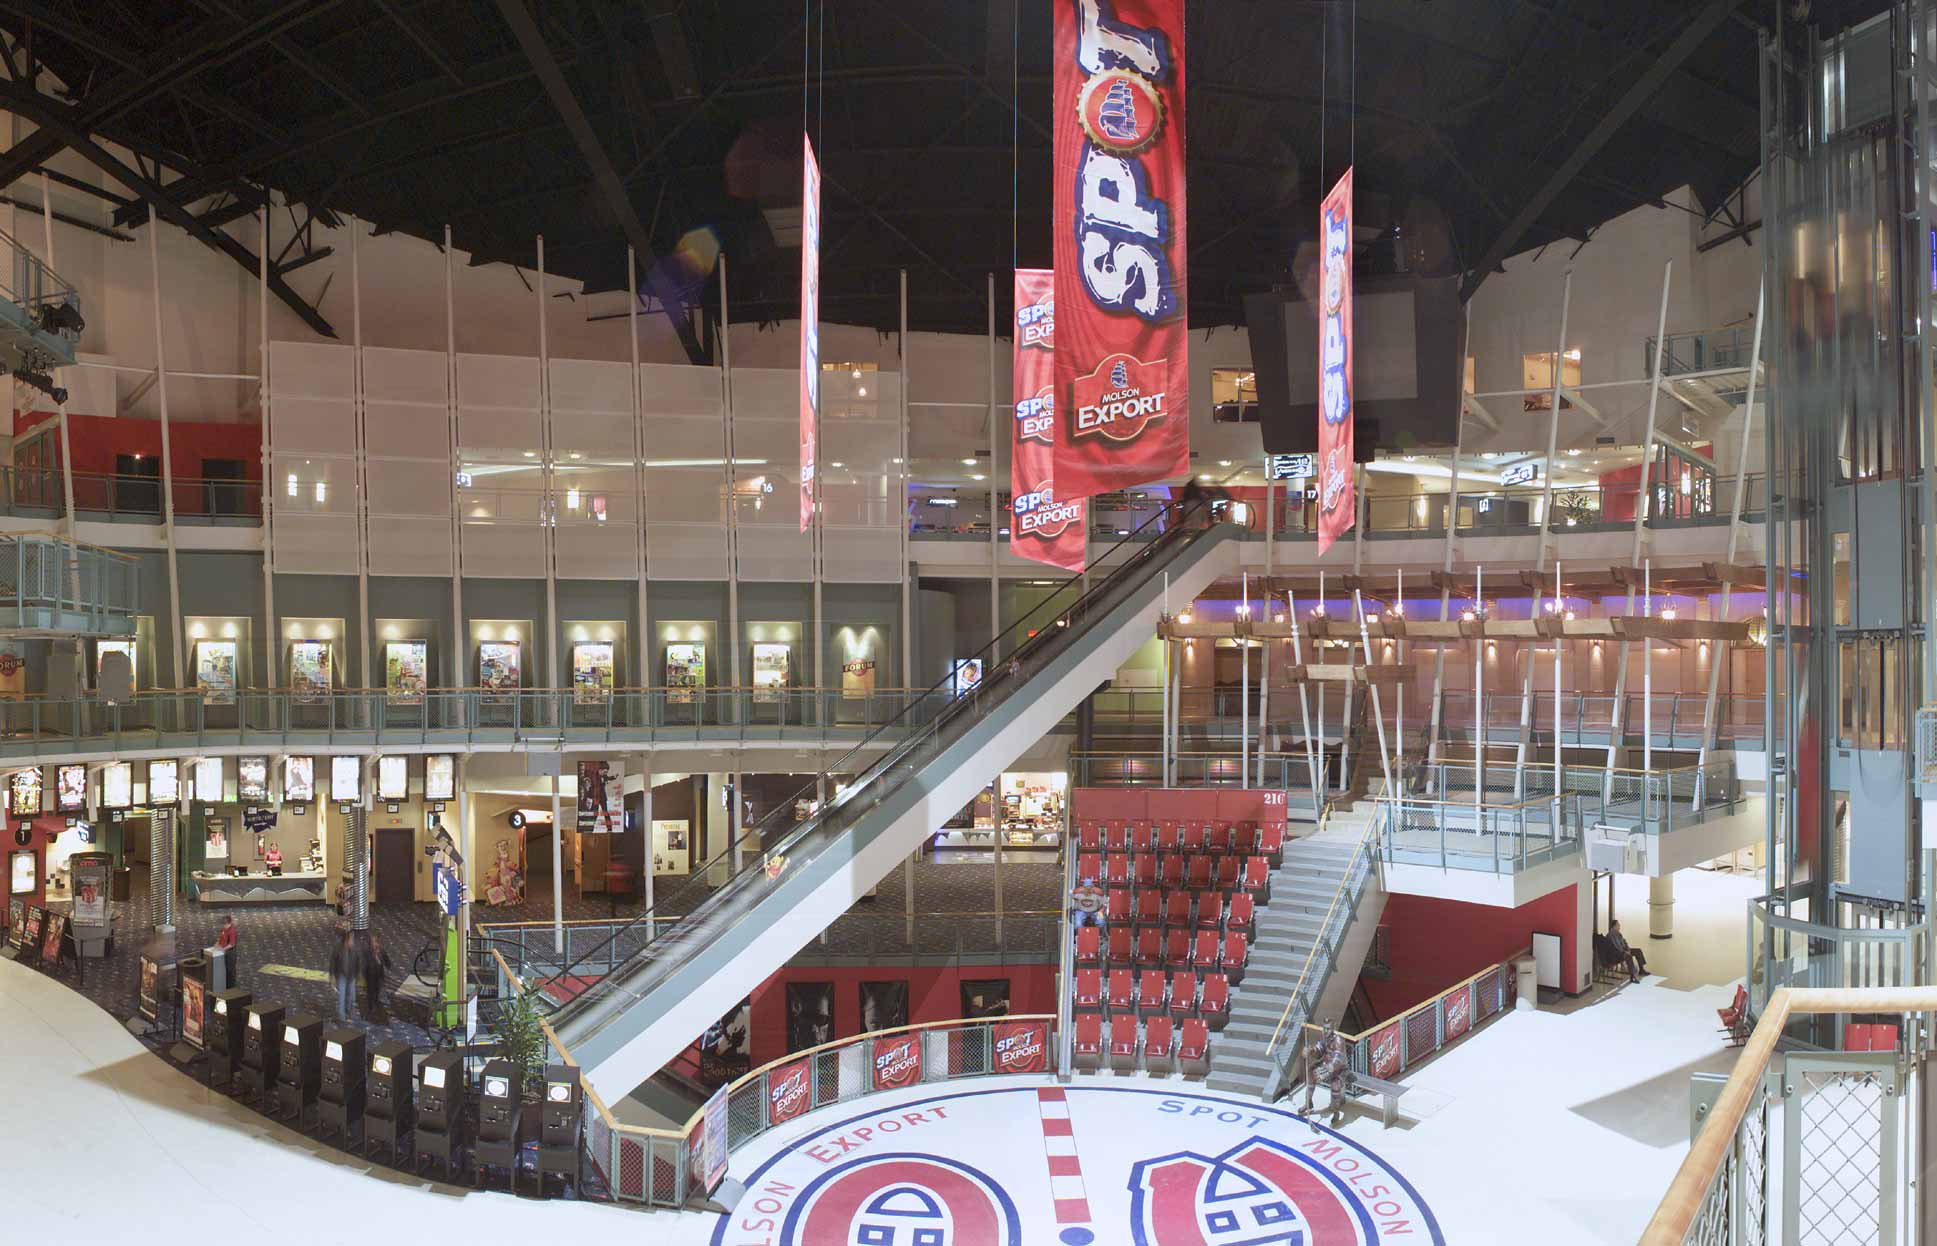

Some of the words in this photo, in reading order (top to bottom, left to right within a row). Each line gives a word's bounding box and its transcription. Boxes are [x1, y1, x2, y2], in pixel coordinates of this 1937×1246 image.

[1018, 301, 1054, 326] SPO
[1025, 323, 1054, 341] EXP
[1016, 394, 1054, 418] SPO
[1101, 386, 1141, 404] MOLSON
[1077, 392, 1166, 430] EXPORT
[1023, 417, 1054, 434] EXP
[1015, 488, 1054, 514] SPO
[1306, 489, 1318, 499] 17
[1021, 504, 1080, 530] EXPORT
[997, 1031, 1035, 1053] SPOT
[1001, 1043, 1042, 1063] EXPORT
[877, 1042, 912, 1069] SPOT
[881, 1054, 919, 1080] EXPORT
[772, 1070, 803, 1102] SPOT
[776, 1082, 808, 1113] EXPORT
[1157, 1099, 1270, 1130] SPOT
[804, 1106, 949, 1164] EXPORT
[1302, 1137, 1414, 1236] MOLSON
[735, 1180, 796, 1246] LSON
